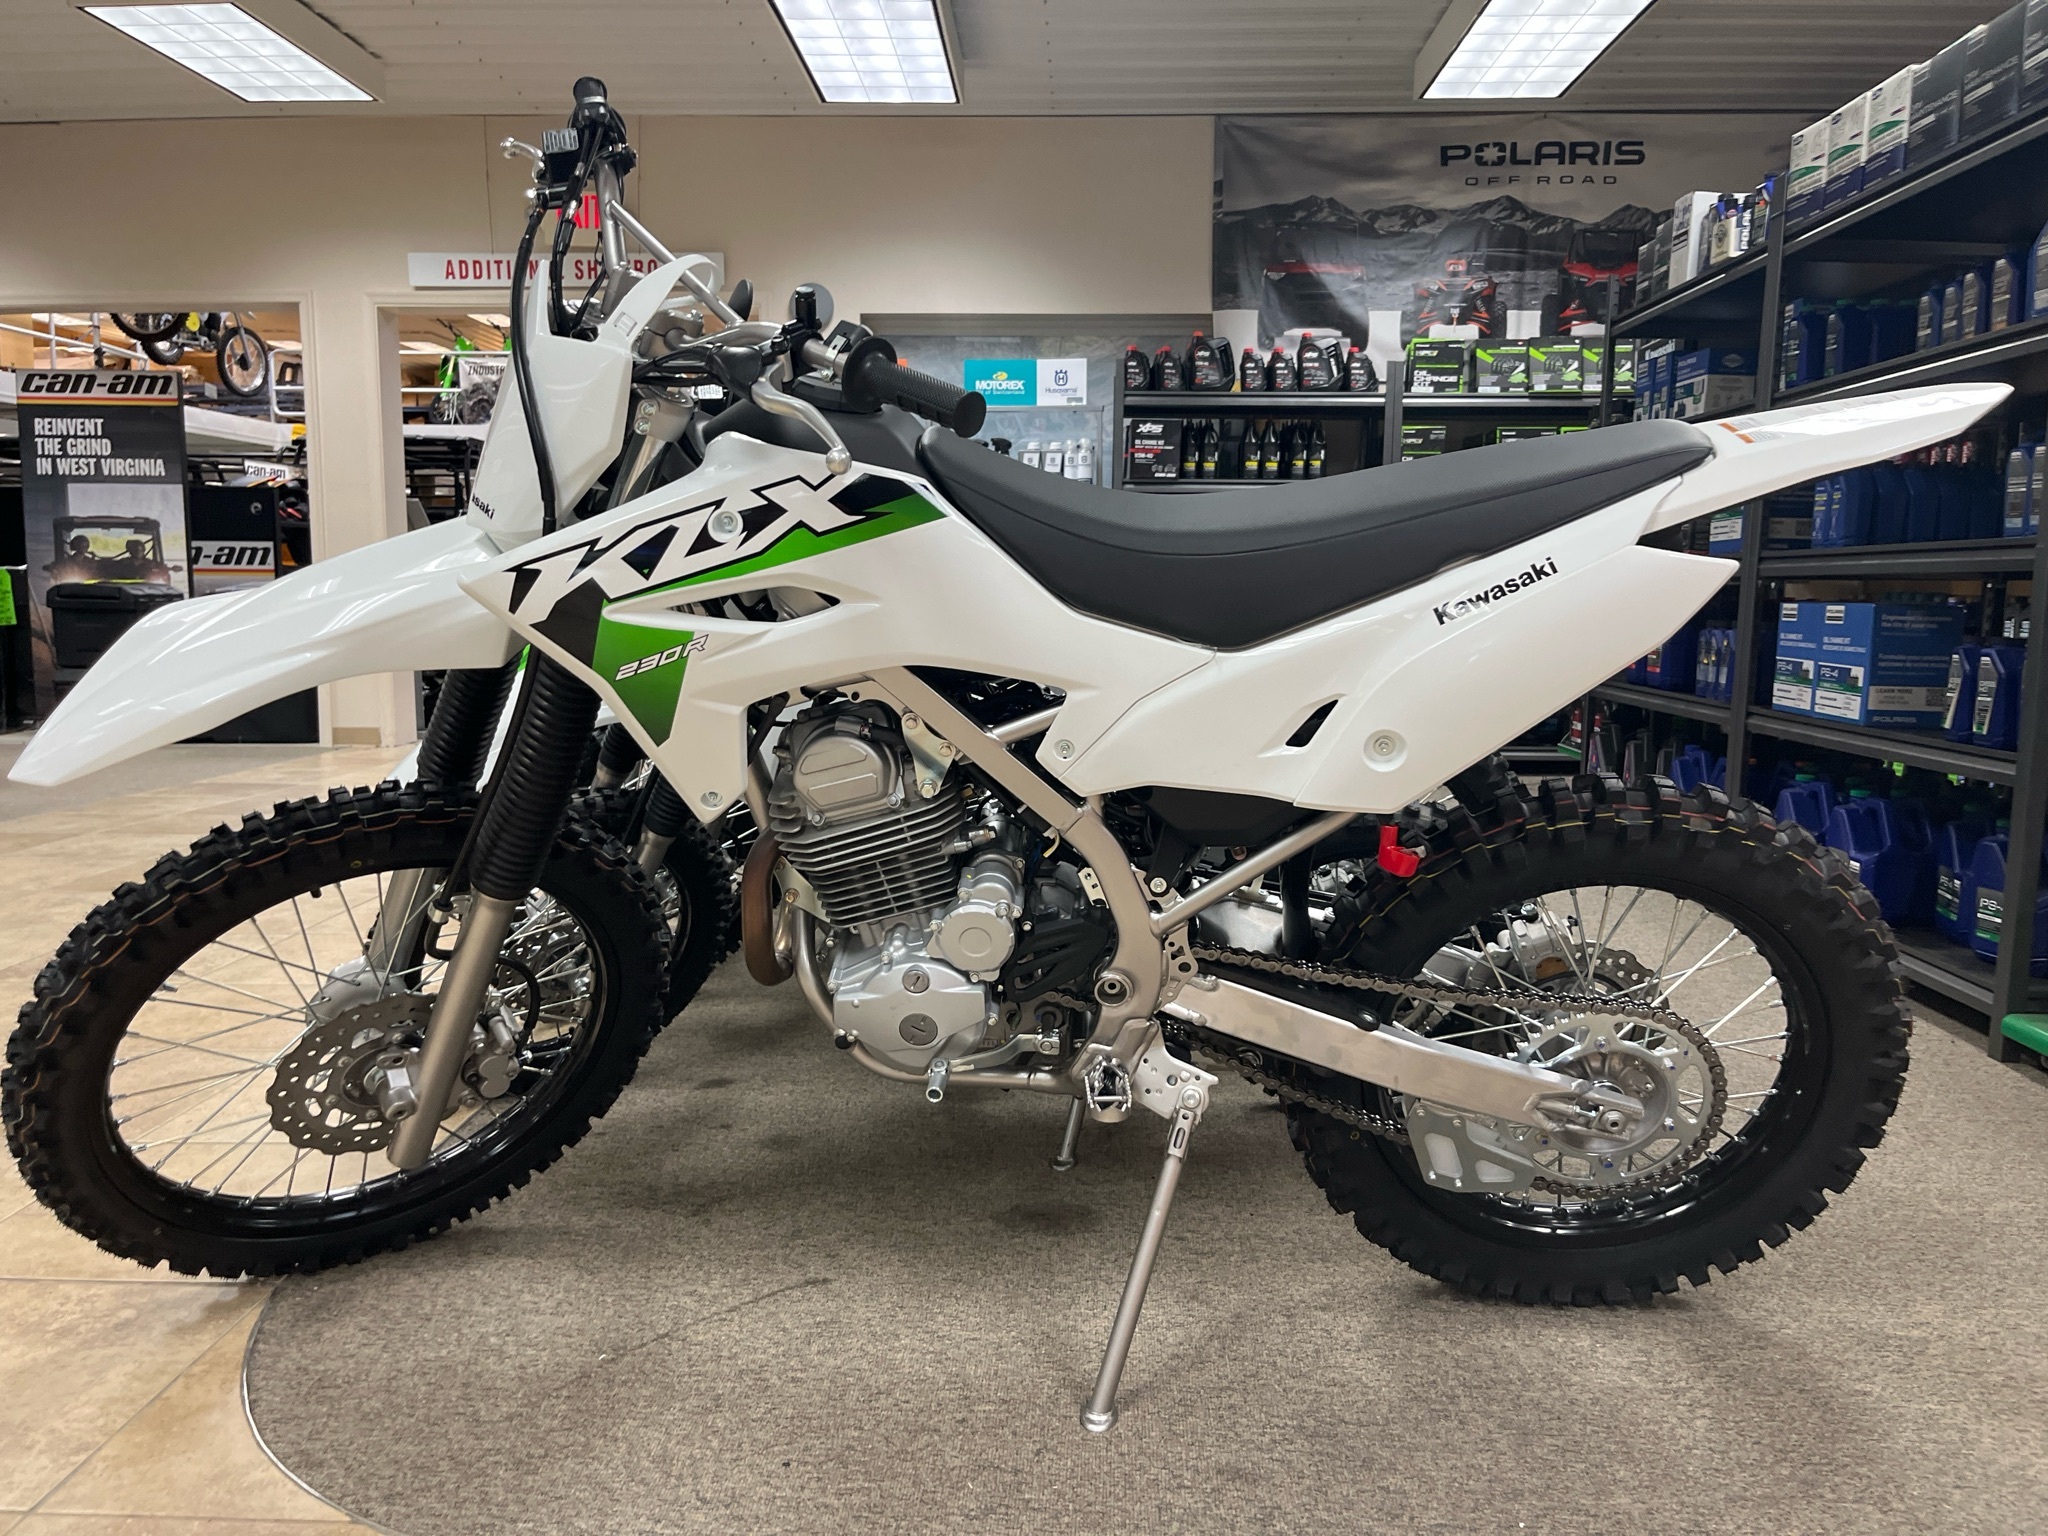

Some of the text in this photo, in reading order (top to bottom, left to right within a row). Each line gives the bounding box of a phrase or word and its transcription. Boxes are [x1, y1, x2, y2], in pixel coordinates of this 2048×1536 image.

[1440, 140, 1646, 167] POLARIS
[1465, 175, 1618, 186] OFF ROAD
[20, 373, 174, 395] can-am
[975, 380, 1025, 391] MOTOREX
[34, 417, 104, 436] REINVENT
[35, 438, 112, 456] THE GRIND
[37, 457, 166, 477] IN WEST VIRGINIA
[503, 474, 868, 626] KLX
[1433, 556, 1558, 626] Kawasaki
[614, 633, 709, 682] 230R
